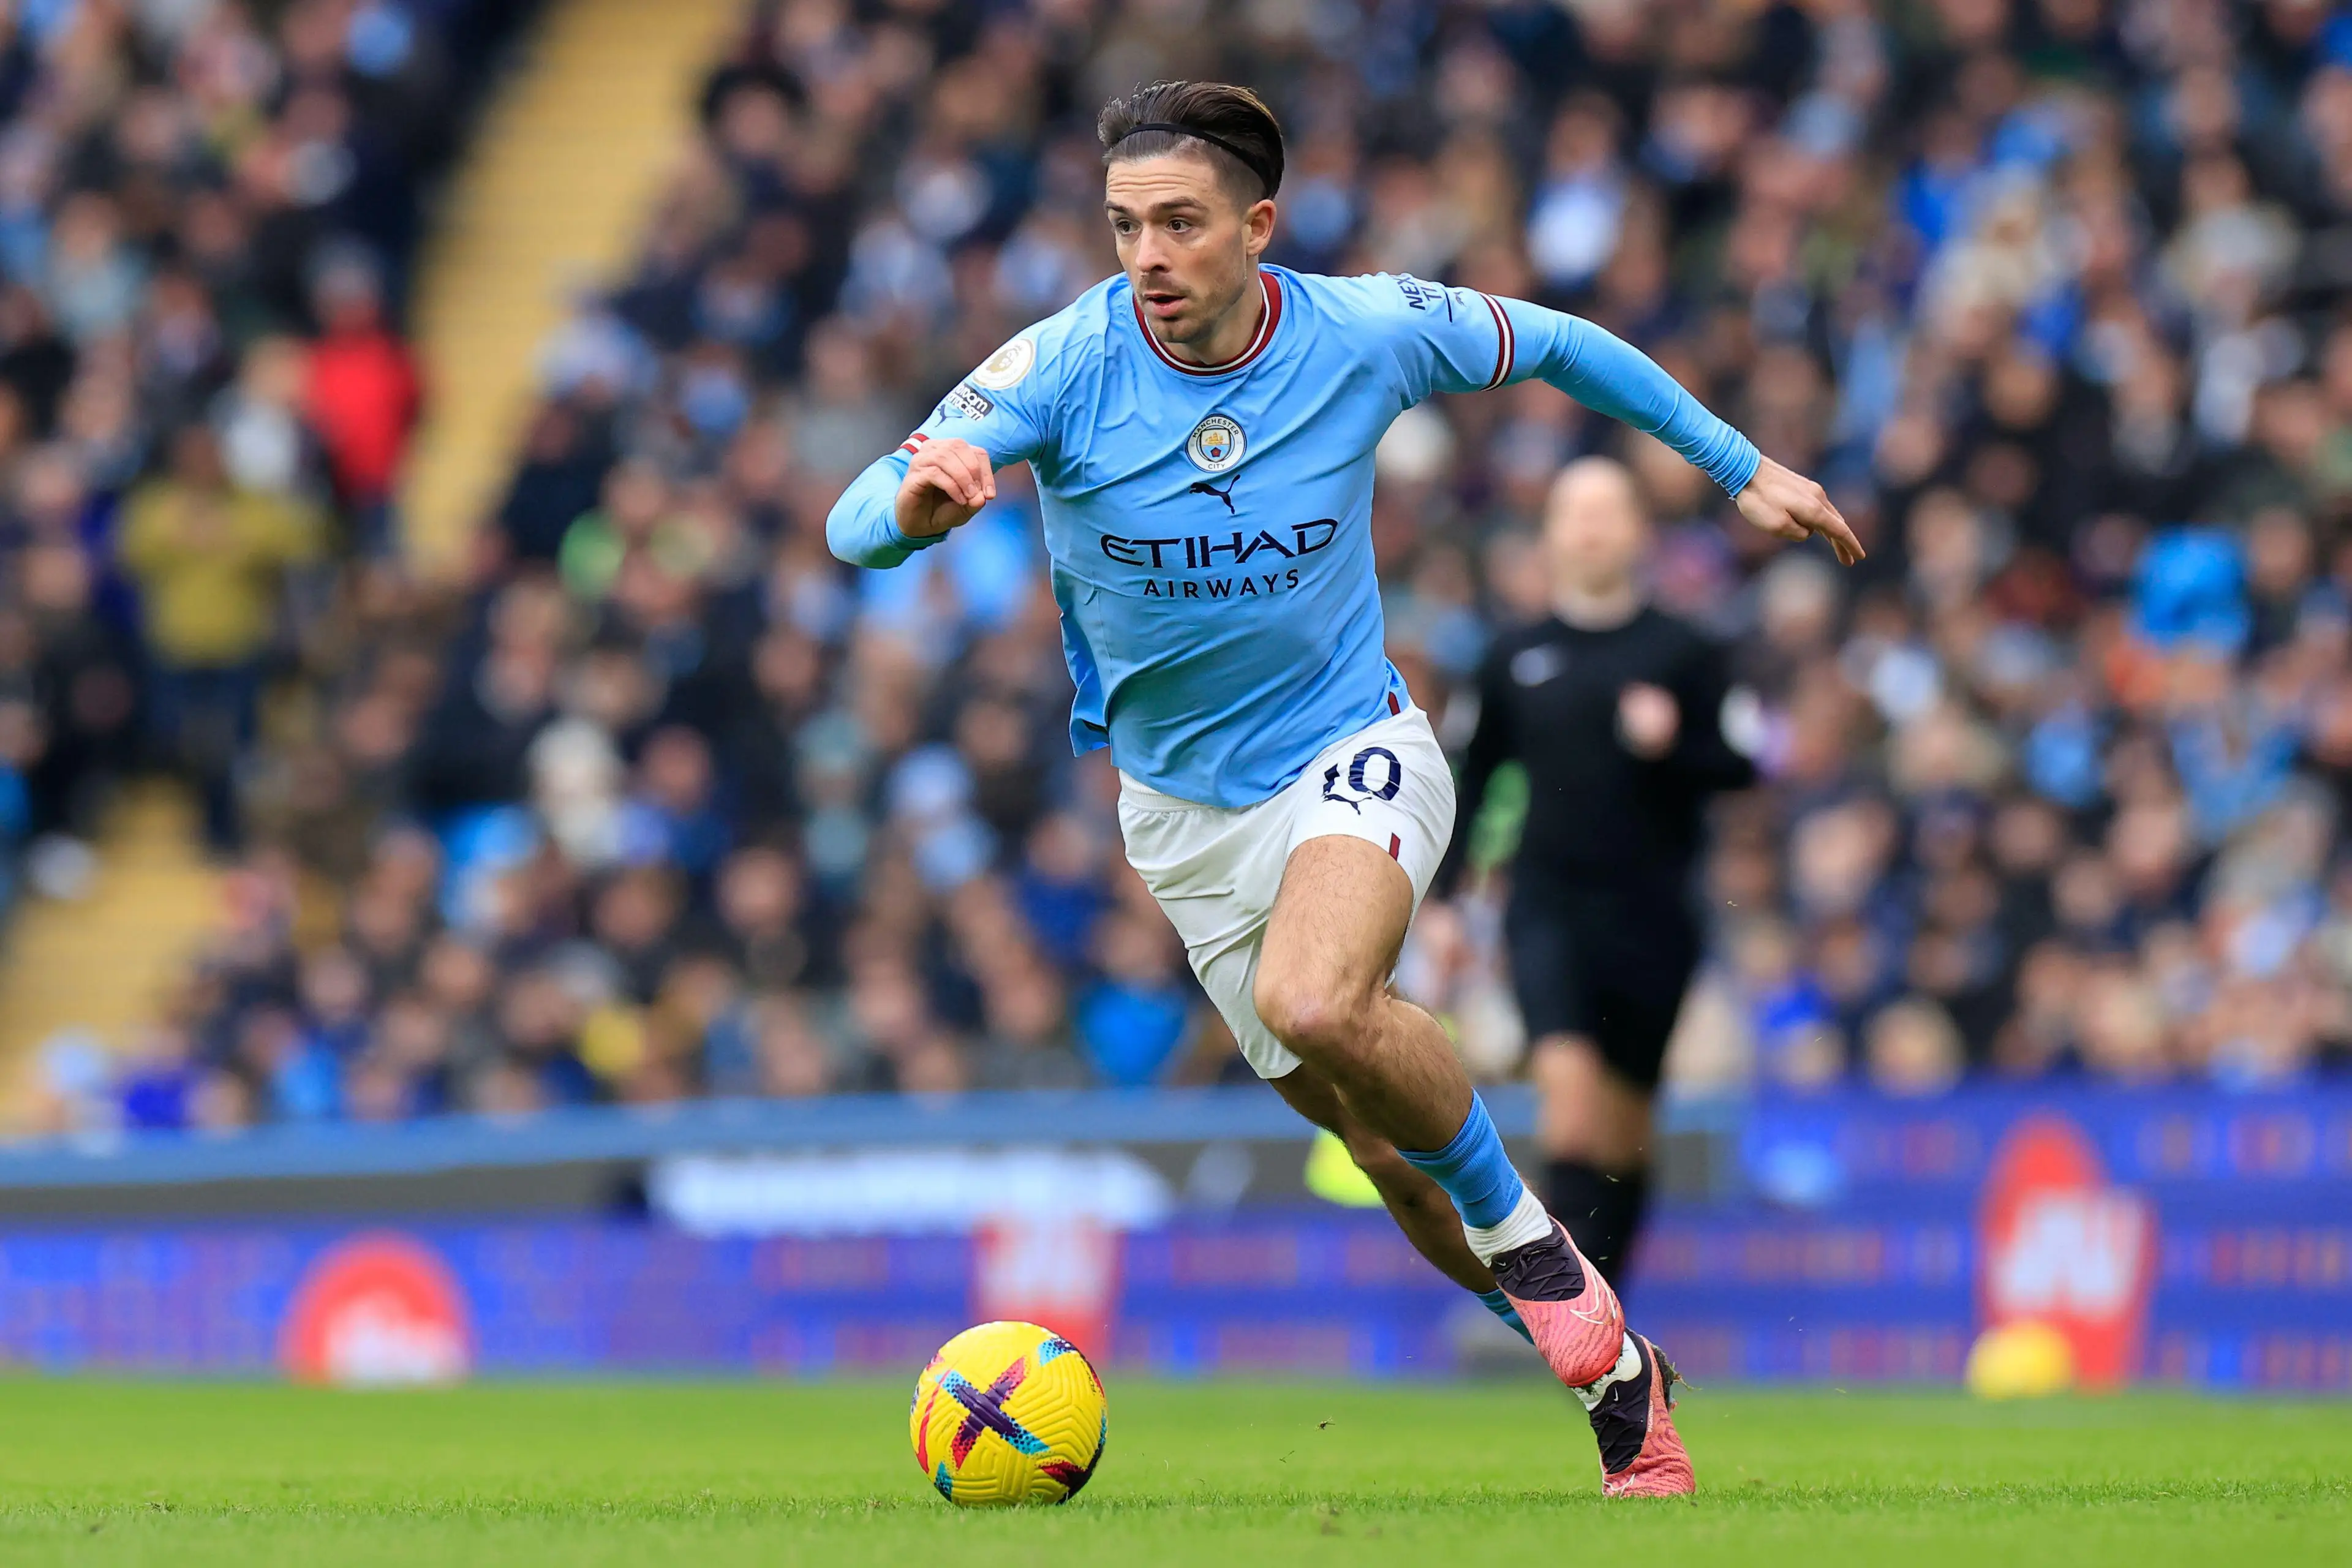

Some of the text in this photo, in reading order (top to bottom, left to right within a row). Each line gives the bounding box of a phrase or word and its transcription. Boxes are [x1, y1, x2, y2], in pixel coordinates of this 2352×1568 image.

[1192, 418, 1240, 438] MANCHESTER
[1100, 518, 1338, 568] ETIHAD
[1143, 568, 1299, 598] AIRWAYS
